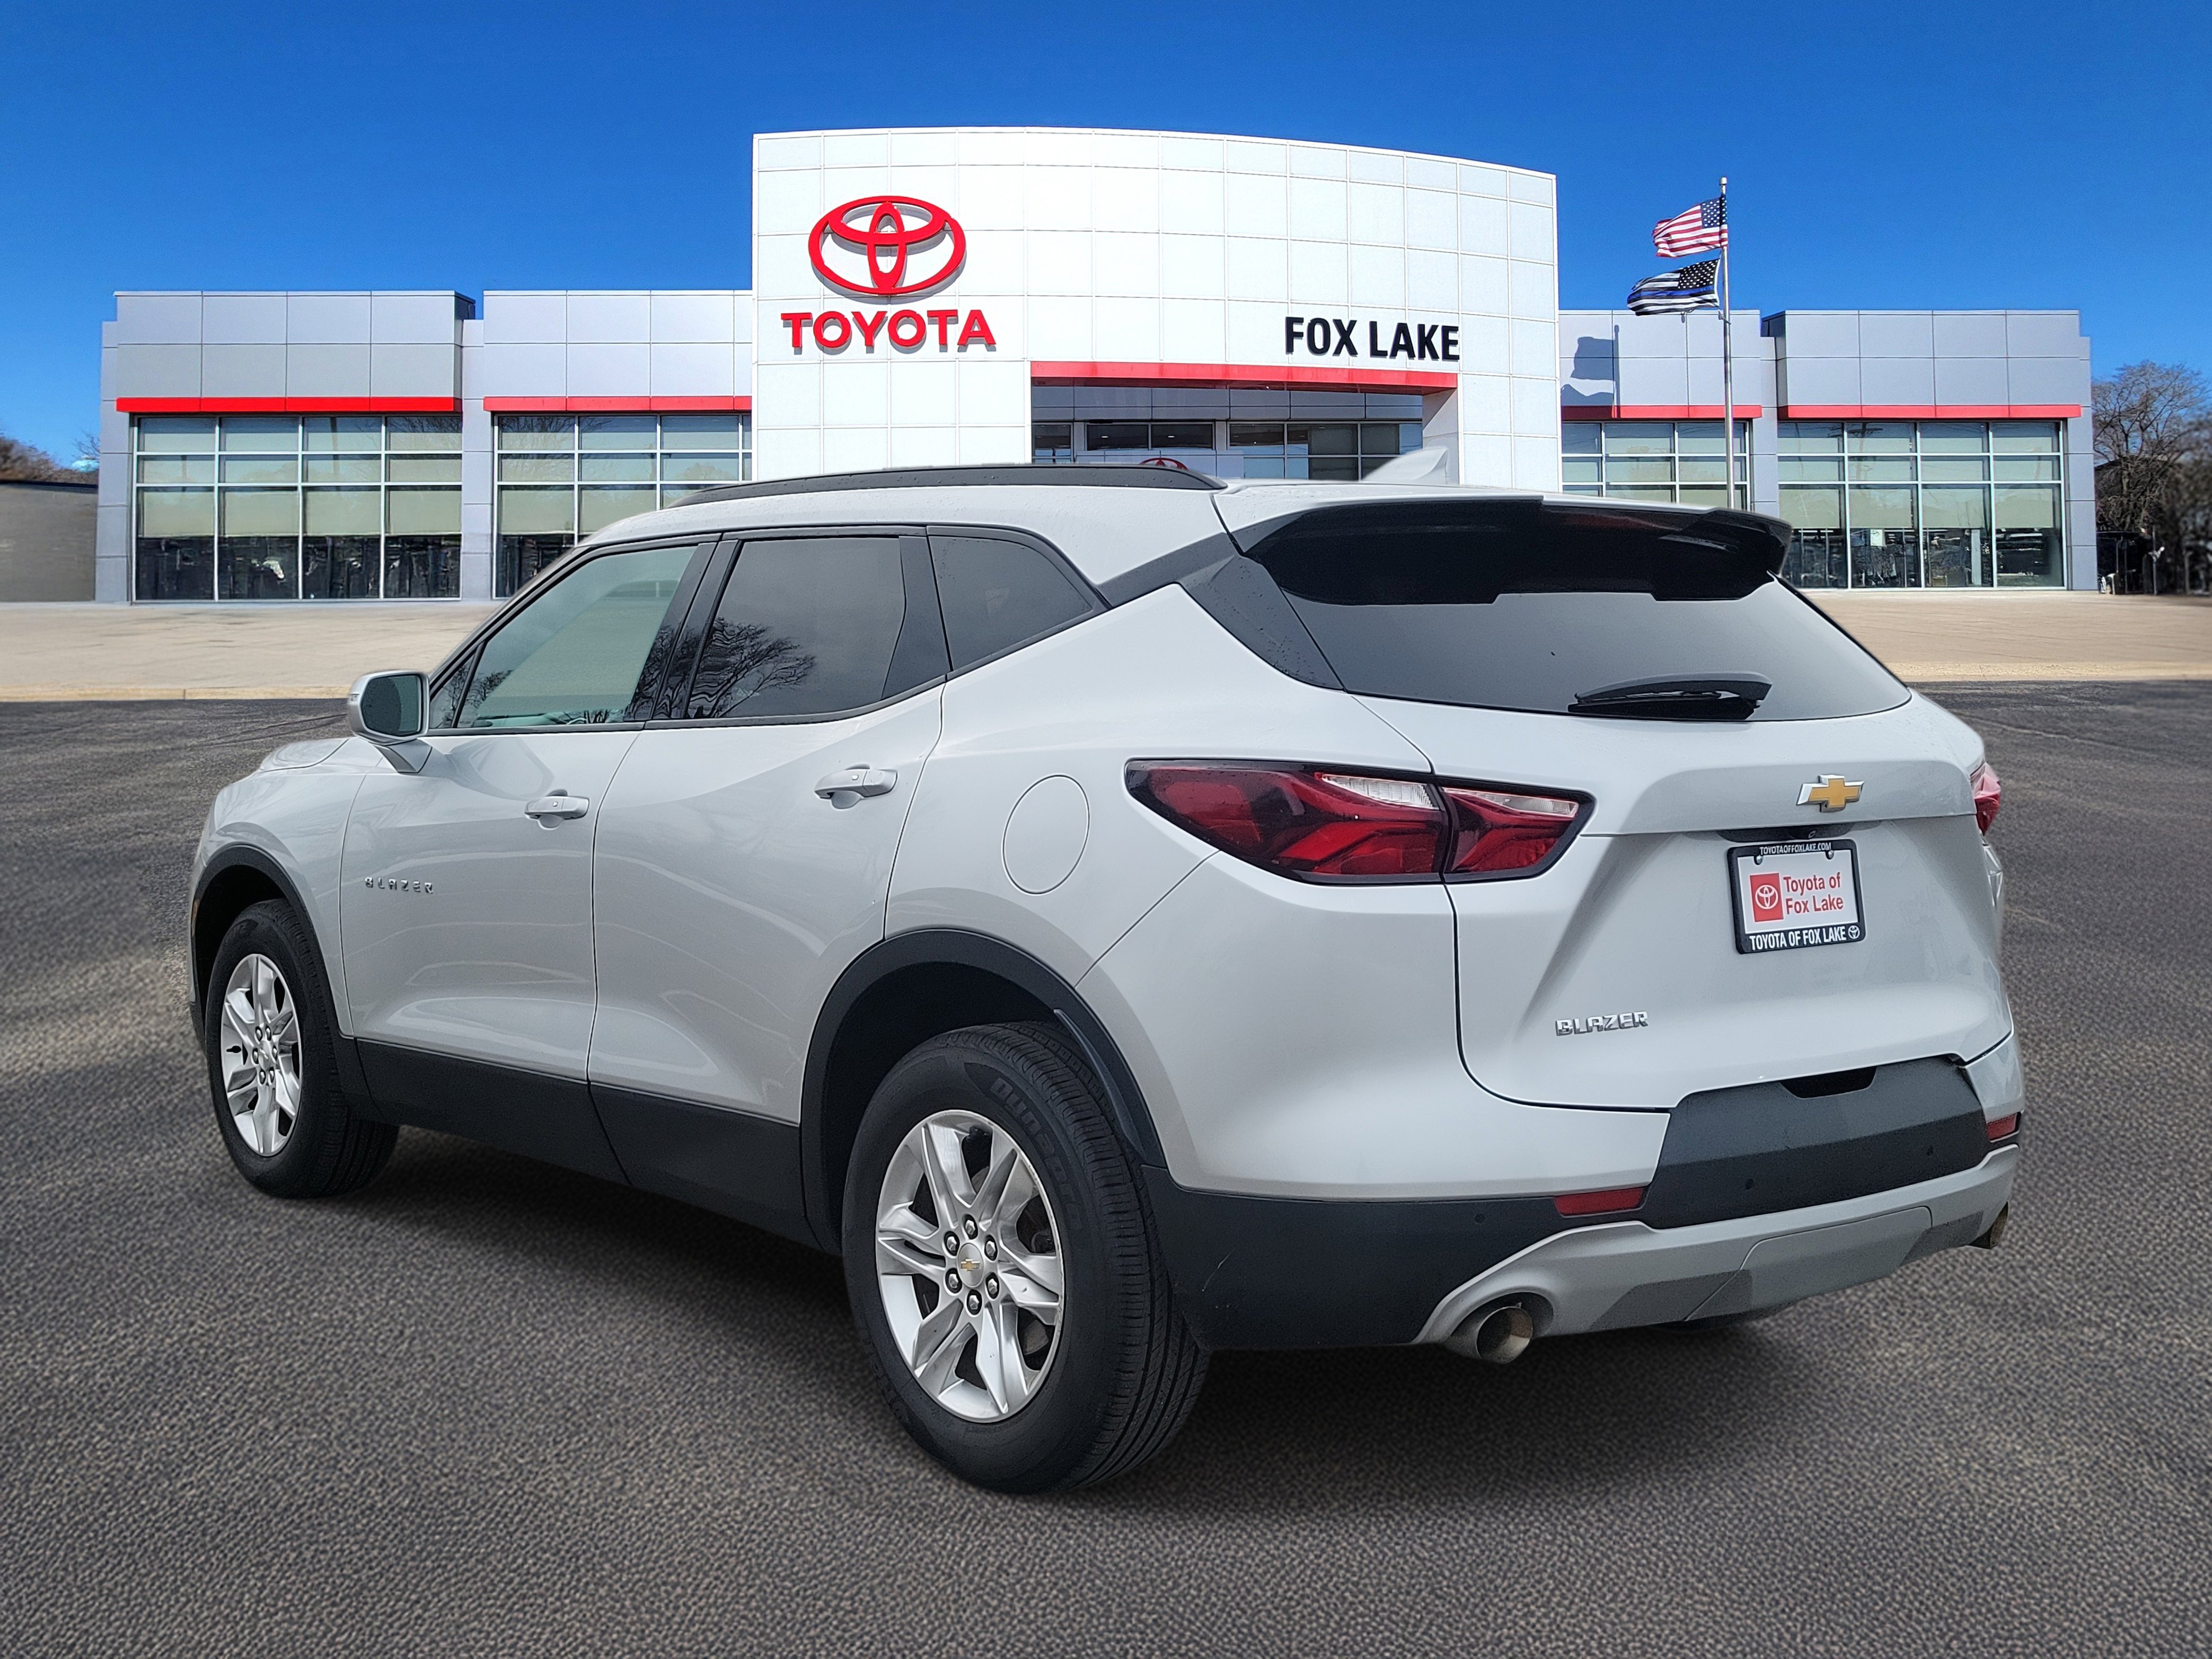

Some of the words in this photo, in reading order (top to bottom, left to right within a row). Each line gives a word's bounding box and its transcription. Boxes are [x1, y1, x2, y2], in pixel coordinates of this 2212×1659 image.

[781, 309, 997, 354] TOYOTA
[1285, 316, 1358, 357] FOX
[1369, 321, 1460, 361] LAKE
[1759, 842, 1831, 855] TOYOTAOFFOXLAKE.COM
[365, 877, 433, 894] BLAZER
[1783, 875, 1825, 895] Toyota
[1829, 872, 1841, 888] of
[1785, 898, 1809, 914] Fox
[1812, 894, 1844, 912] Lake
[1750, 931, 1787, 950] TOYOTA
[1788, 930, 1801, 947] OF
[1803, 928, 1821, 945] FOX
[1823, 926, 1847, 942] LAKE
[1555, 1011, 1649, 1036] BLAZER
